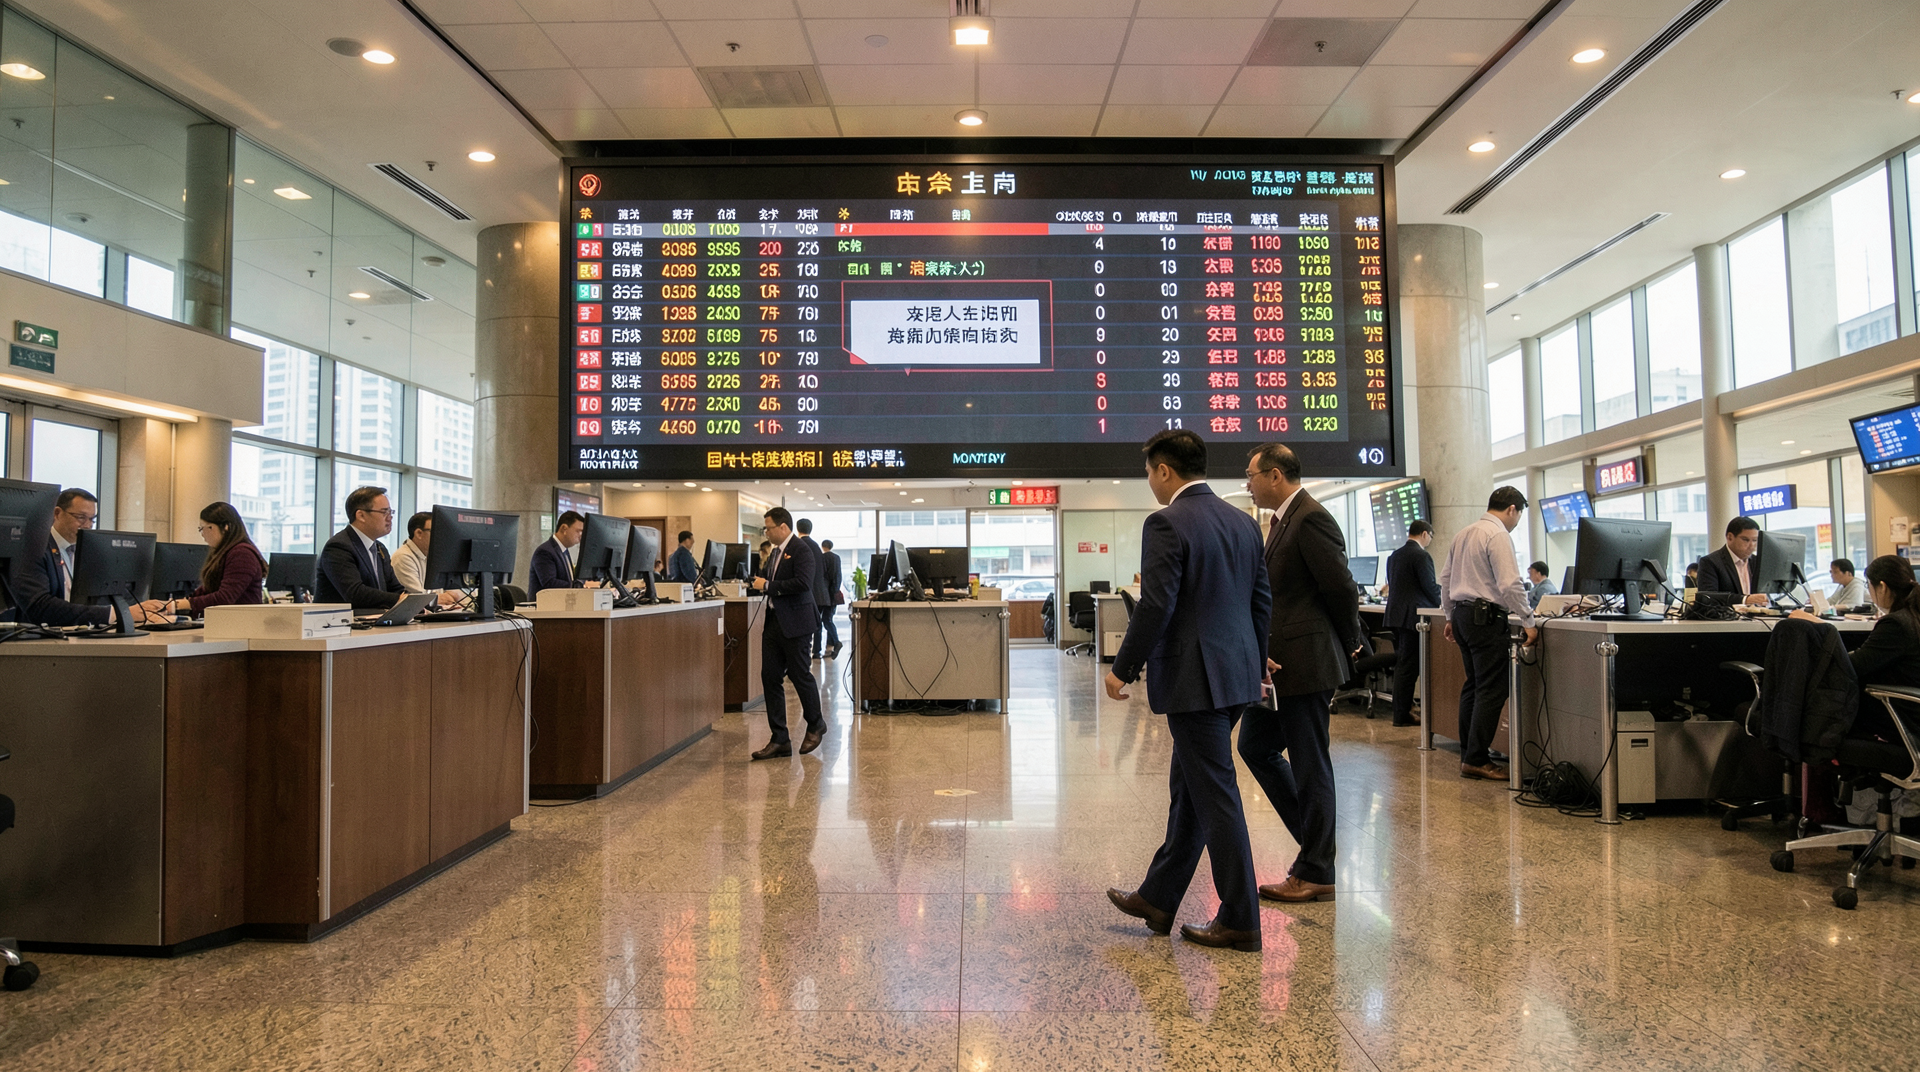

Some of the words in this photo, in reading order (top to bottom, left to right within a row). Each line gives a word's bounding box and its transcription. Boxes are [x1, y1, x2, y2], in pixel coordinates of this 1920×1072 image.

[760, 242, 781, 255] 200
[1096, 306, 1105, 320] 0
[1162, 306, 1177, 319] 01
[1097, 328, 1105, 342] 9
[1162, 328, 1179, 341] 20
[1097, 351, 1105, 364] 0
[1098, 396, 1107, 410] 0
[1099, 418, 1105, 433] 1
